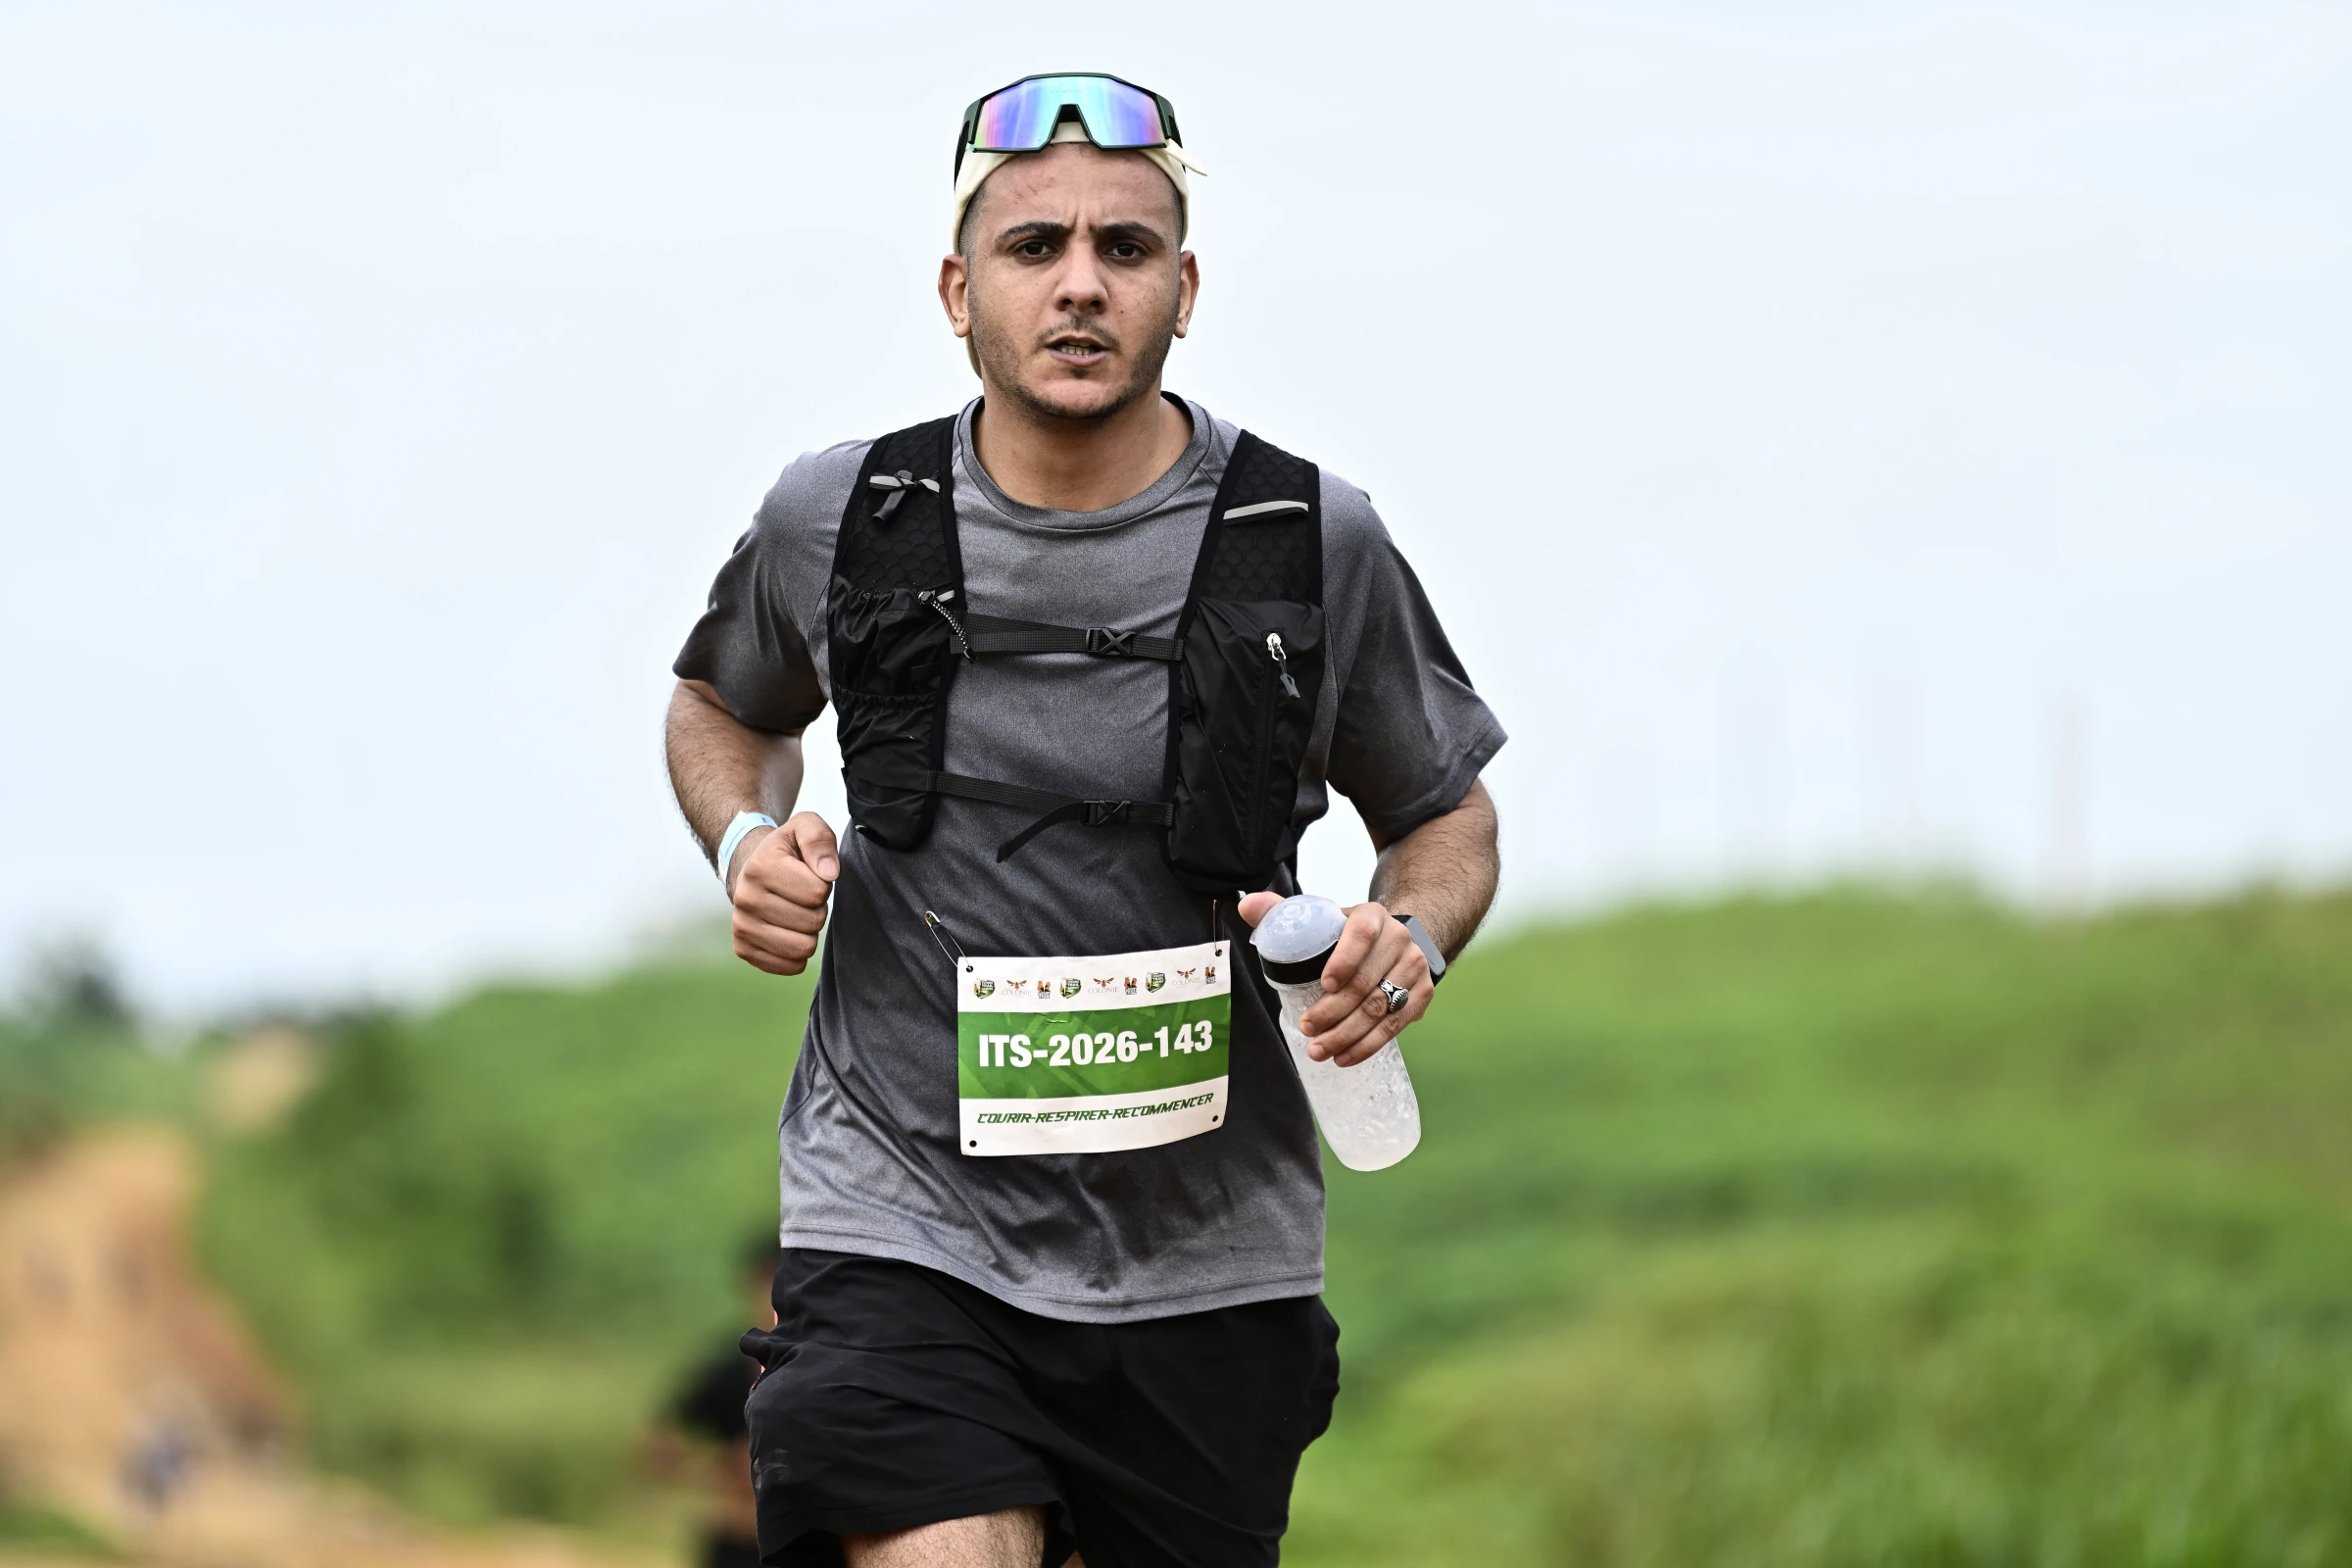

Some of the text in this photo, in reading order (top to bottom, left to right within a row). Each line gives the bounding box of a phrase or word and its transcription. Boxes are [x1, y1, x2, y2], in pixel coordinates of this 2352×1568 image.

[1172, 977, 1201, 987] COLONIE
[979, 1020, 1213, 1068] ITS-2026-143
[977, 1093, 1214, 1124] COURIR-RESPIRER-RECOMMENCER
